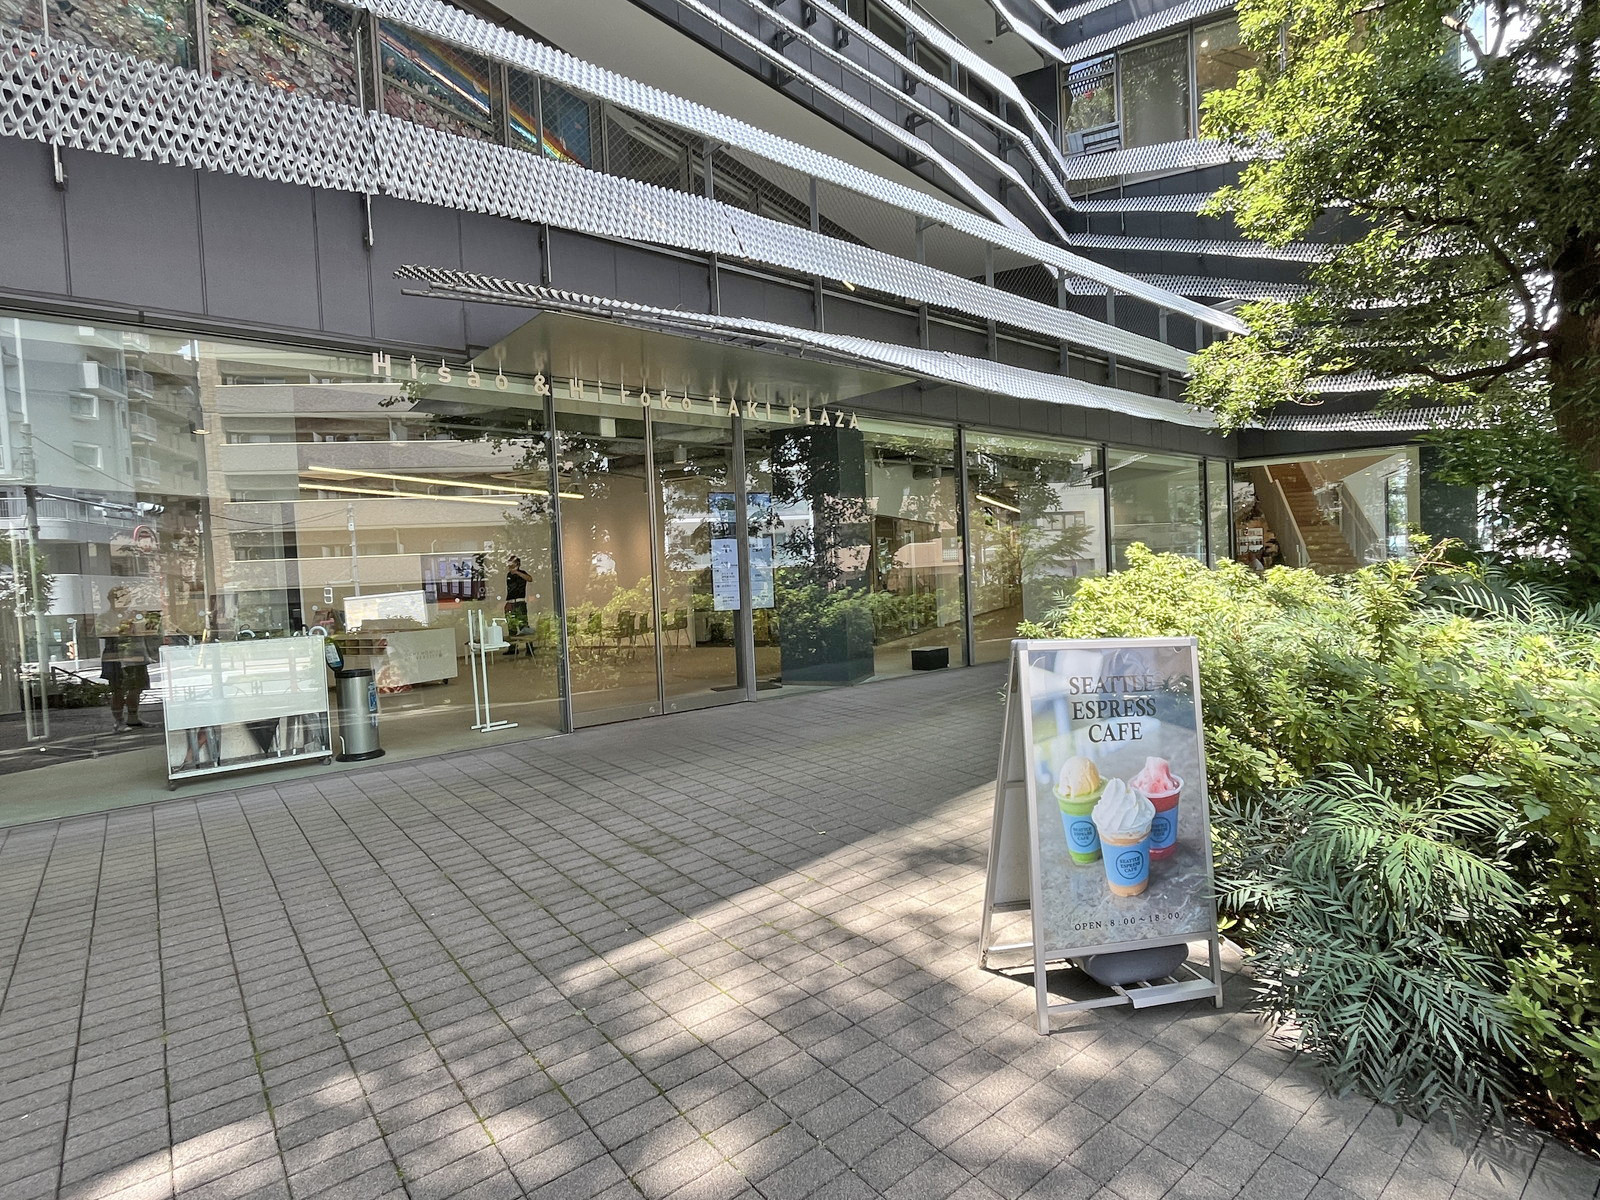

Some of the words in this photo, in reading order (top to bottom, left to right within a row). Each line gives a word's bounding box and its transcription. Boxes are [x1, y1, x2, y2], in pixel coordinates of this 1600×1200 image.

[372, 352, 508, 390] Hisao
[534, 374, 551, 396] &
[568, 377, 692, 412] Hiroko
[709, 396, 771, 420] TAKI
[789, 406, 859, 430] PLAZA
[1069, 674, 1155, 695] SEATTLE
[1071, 698, 1157, 720] ESPRESS
[1088, 722, 1143, 743] CAFE
[1074, 920, 1102, 931] OPEN
